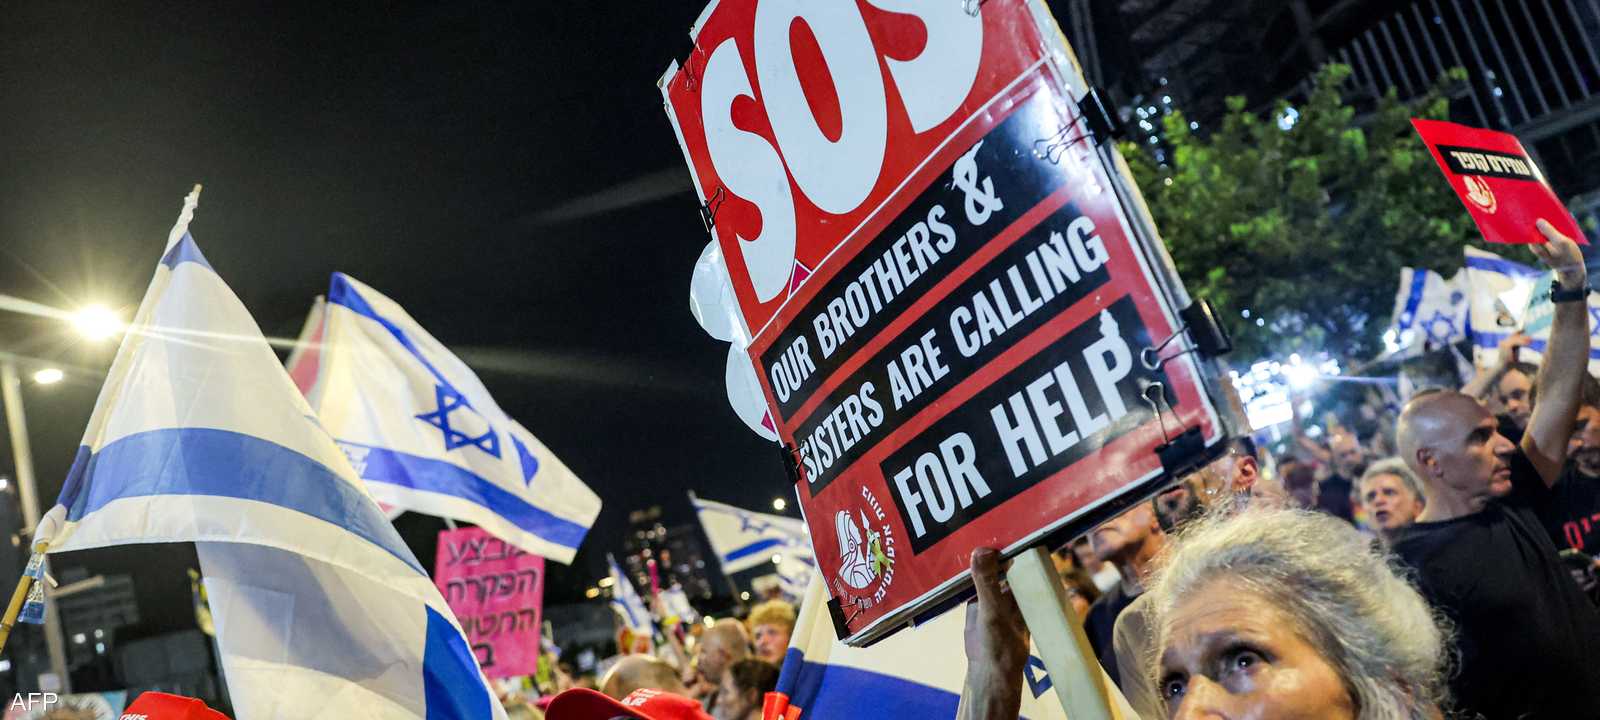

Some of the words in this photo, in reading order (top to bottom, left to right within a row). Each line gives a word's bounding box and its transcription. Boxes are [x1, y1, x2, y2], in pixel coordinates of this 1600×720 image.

[701, 0, 983, 303] SOS
[770, 342, 816, 403] OUR
[812, 204, 956, 359] BROTHERS
[947, 139, 1004, 226] &
[800, 381, 885, 485] SISTERS
[886, 328, 951, 412] ARE
[949, 216, 1110, 359] CALLING
[893, 431, 992, 539] FOR
[989, 308, 1133, 479] HELP
[861, 485, 886, 521] בונות
